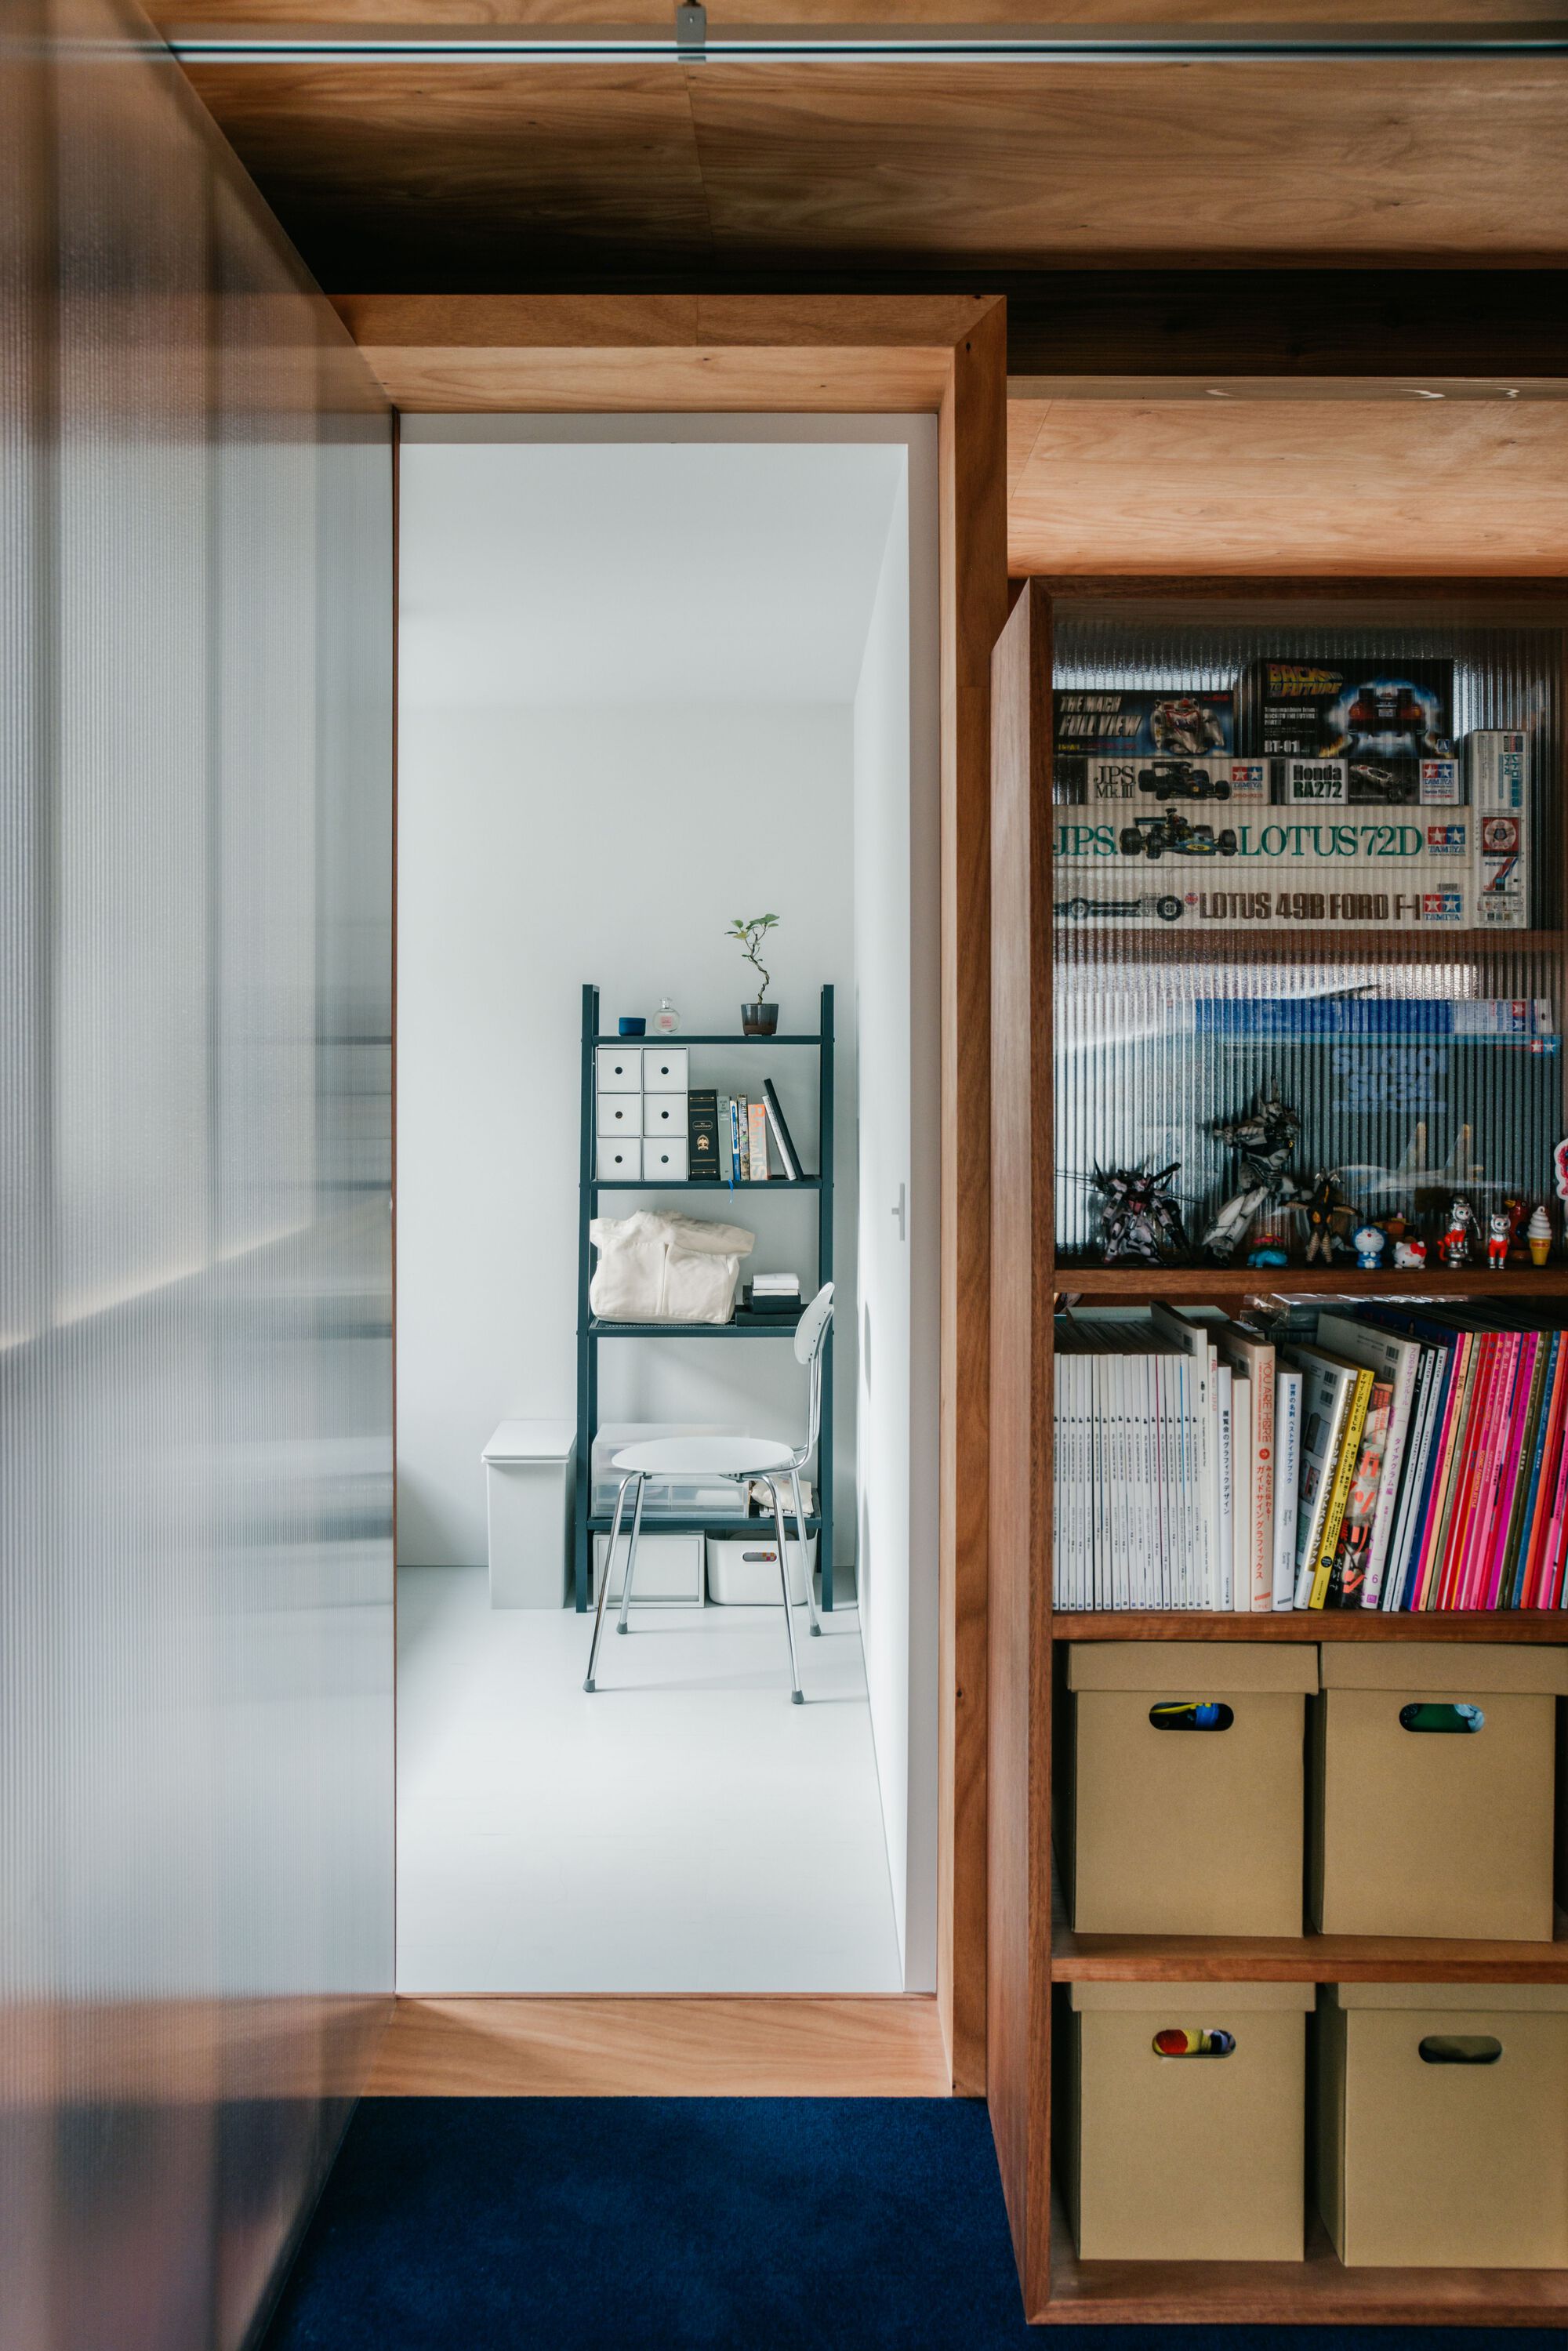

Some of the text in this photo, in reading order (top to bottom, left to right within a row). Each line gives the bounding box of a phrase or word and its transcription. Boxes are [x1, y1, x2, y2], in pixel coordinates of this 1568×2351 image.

[1281, 683, 1342, 697] FUTURE
[1060, 696, 1122, 712] THE MACH
[1059, 715, 1142, 736] FULL VIEW
[1265, 740, 1301, 753] BT-01
[1294, 765, 1342, 781] Honda
[1294, 782, 1342, 798] RA272
[1238, 825, 1359, 856] LOTUS
[1361, 825, 1424, 856] 72D
[1198, 892, 1272, 920] LOTUS
[1276, 892, 1326, 920] 49B
[1330, 893, 1389, 920] FORD
[750, 1105, 766, 1180] BAUHAUS
[1262, 1359, 1273, 1443] YOU ARE HERE
[1386, 1438, 1402, 1496] ダイアグラム編
[1256, 1465, 1265, 1580] ガイドサイングラフィックス
[1372, 1574, 1378, 1584] 6
